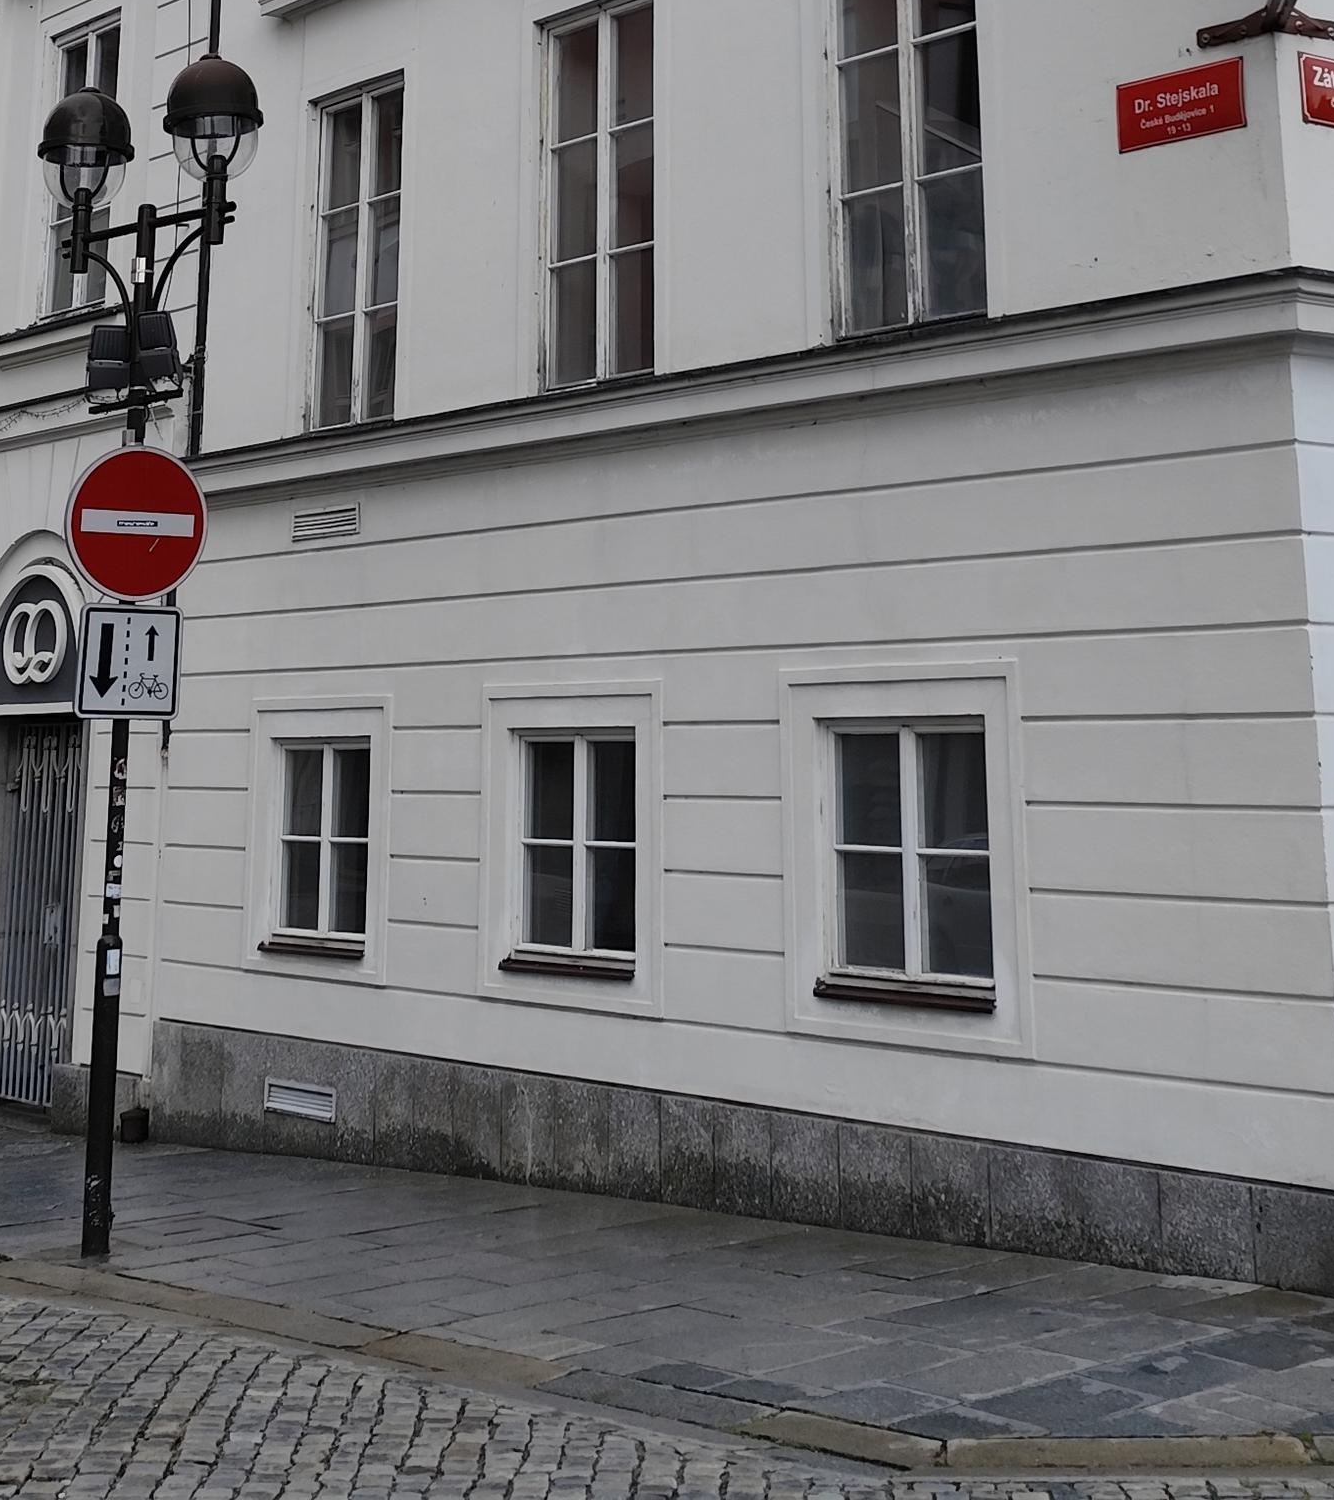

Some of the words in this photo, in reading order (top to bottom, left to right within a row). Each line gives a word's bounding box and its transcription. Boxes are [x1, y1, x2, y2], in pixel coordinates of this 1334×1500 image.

[1134, 98, 1154, 114] Dr.
[1156, 82, 1219, 108] Stejskala
[1140, 117, 1163, 129] České
[1164, 107, 1207, 124] Budějovice
